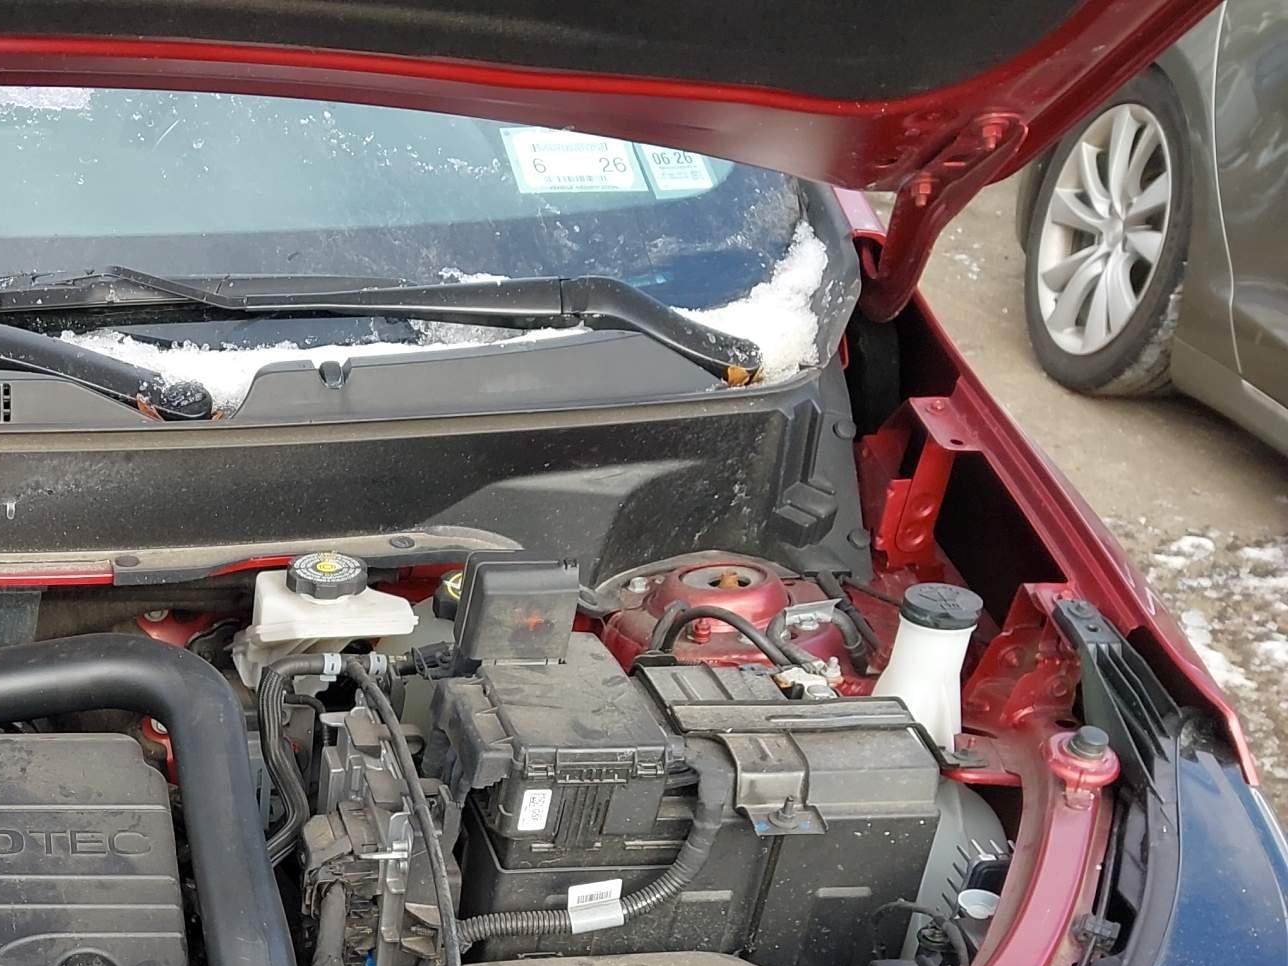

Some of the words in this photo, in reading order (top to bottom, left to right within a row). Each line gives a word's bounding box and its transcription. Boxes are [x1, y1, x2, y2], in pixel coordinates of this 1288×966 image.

[532, 158, 547, 174] 6
[599, 157, 627, 173] 26
[652, 151, 671, 165] 06
[673, 151, 693, 164] 26
